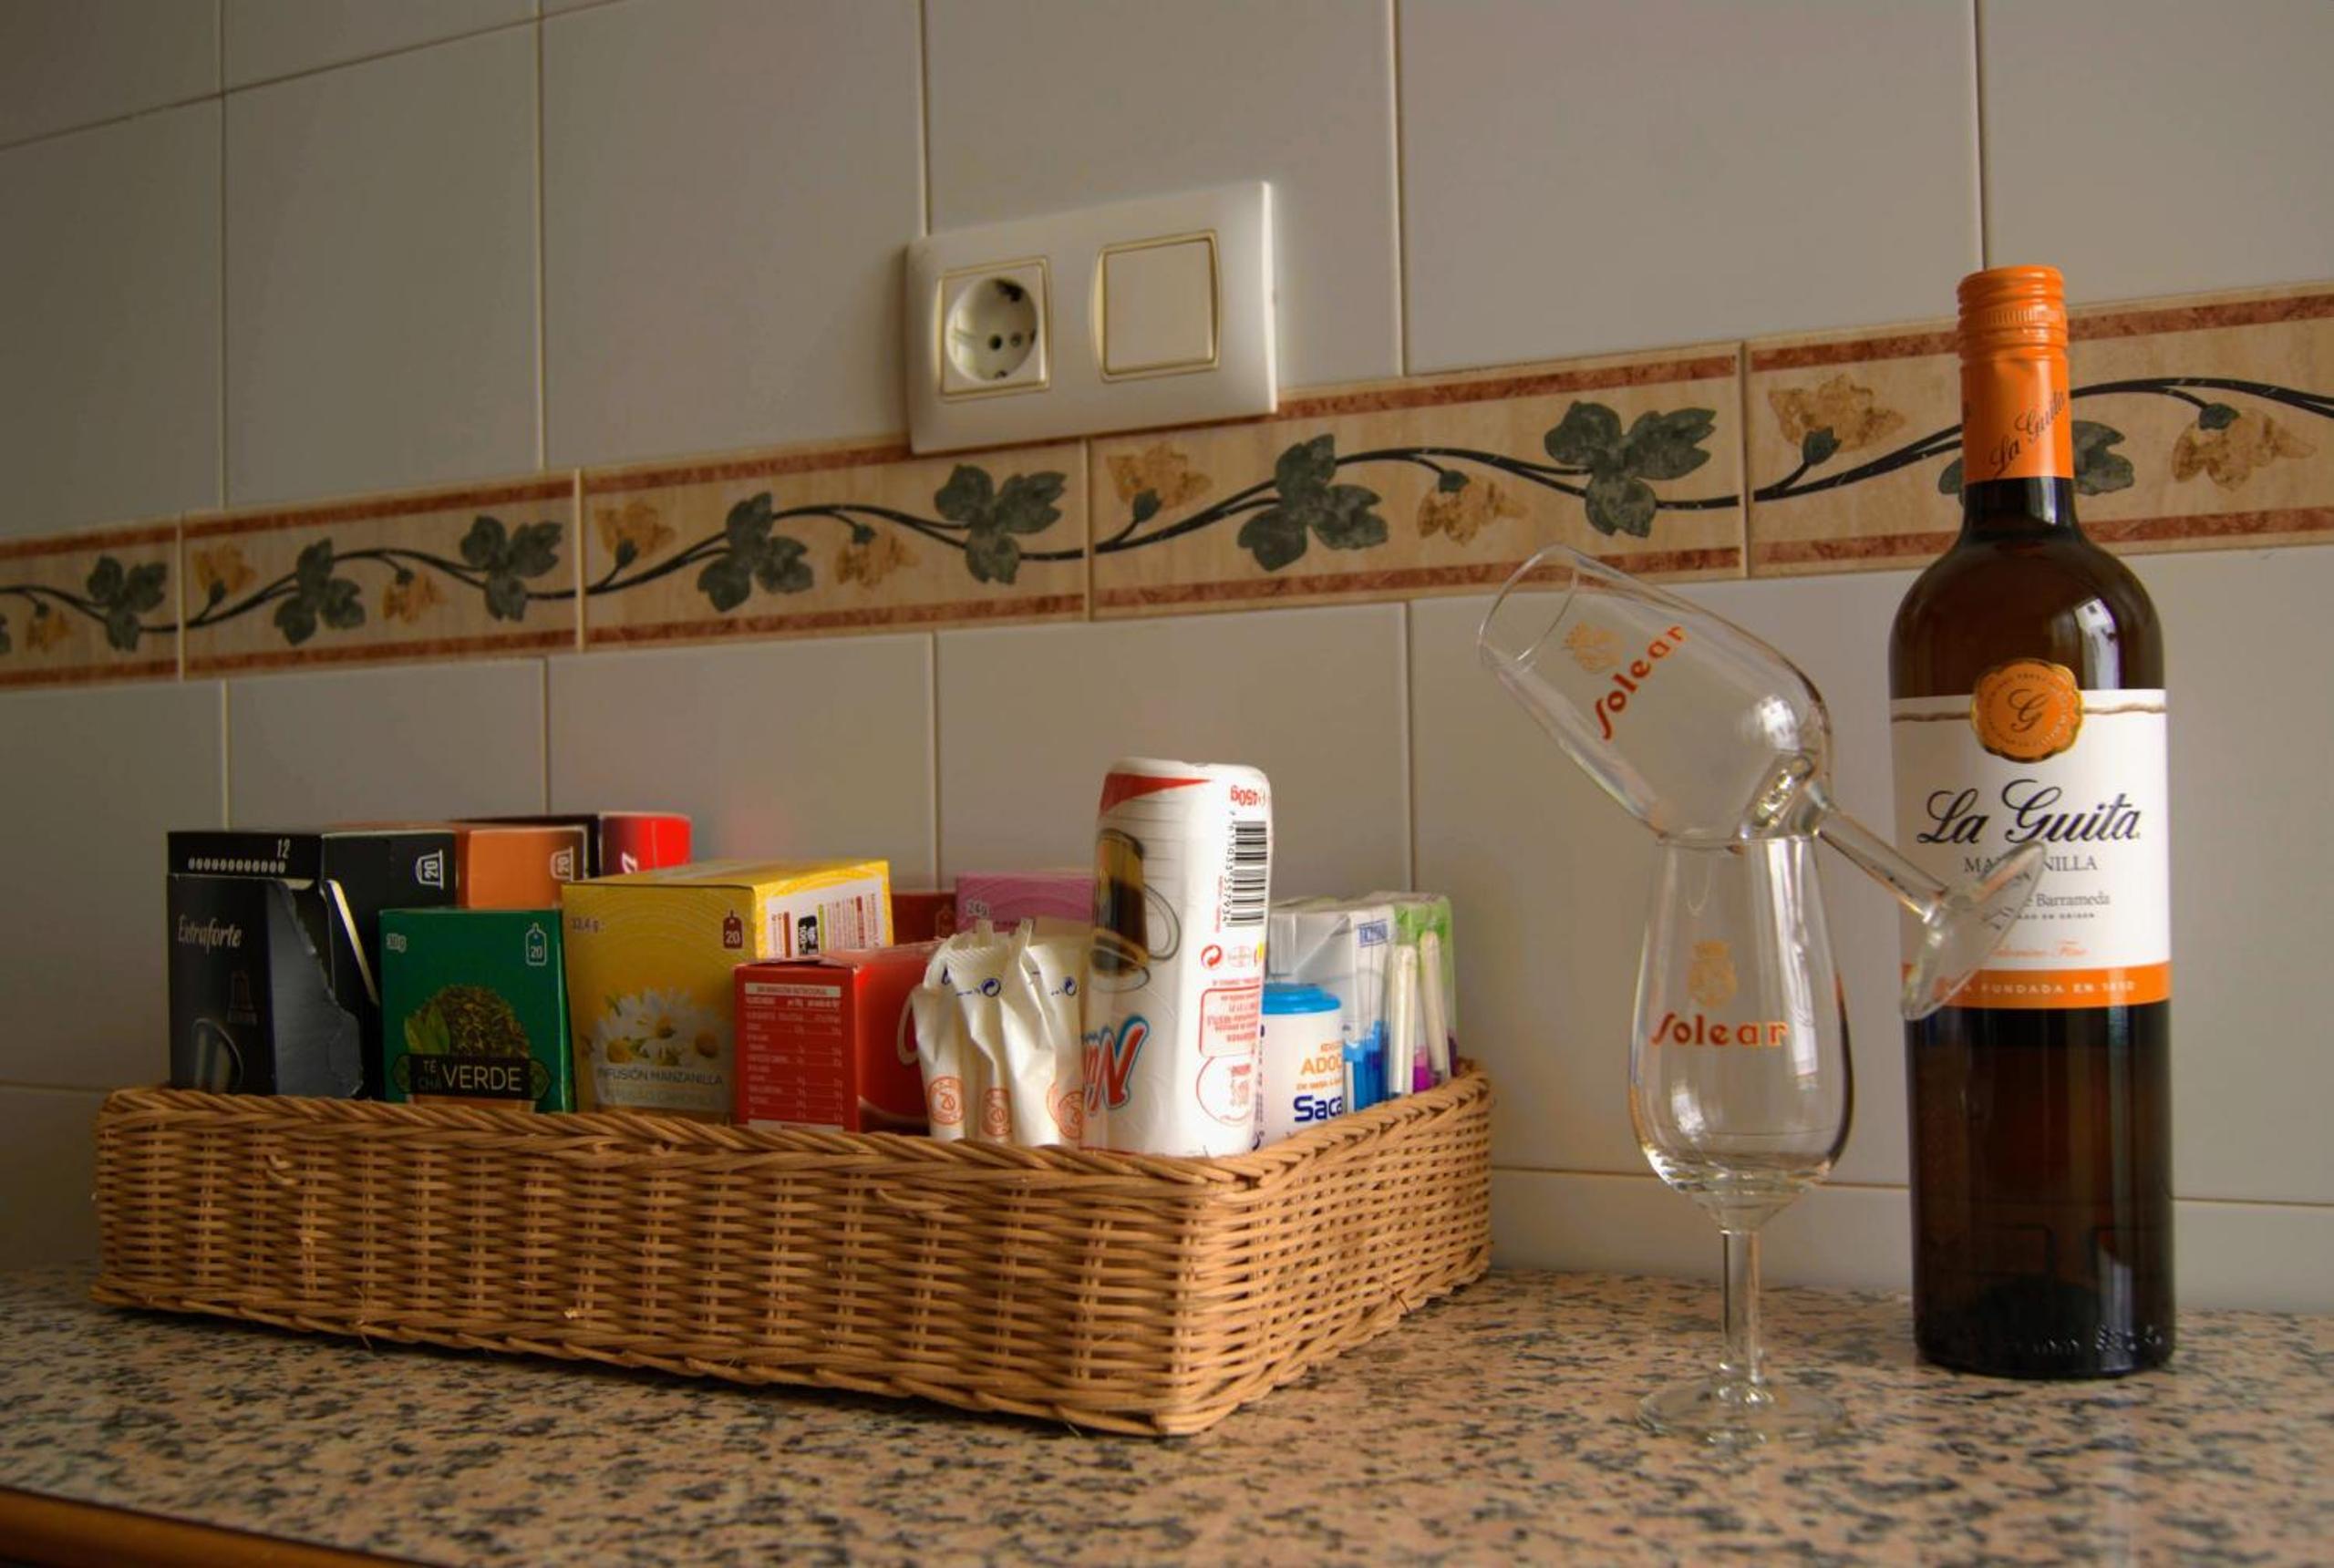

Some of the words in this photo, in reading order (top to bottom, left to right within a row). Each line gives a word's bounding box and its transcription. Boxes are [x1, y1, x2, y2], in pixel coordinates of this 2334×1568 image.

[1916, 788, 1990, 844] La
[2001, 779, 2141, 844] Guita
[276, 837, 291, 860] 12
[2036, 891, 2111, 906] Barrameda
[178, 913, 243, 955] Extraforte
[726, 931, 740, 944] 20
[531, 945, 542, 958] 20
[1651, 1012, 1789, 1046] Solear
[442, 1063, 523, 1092] VERDE
